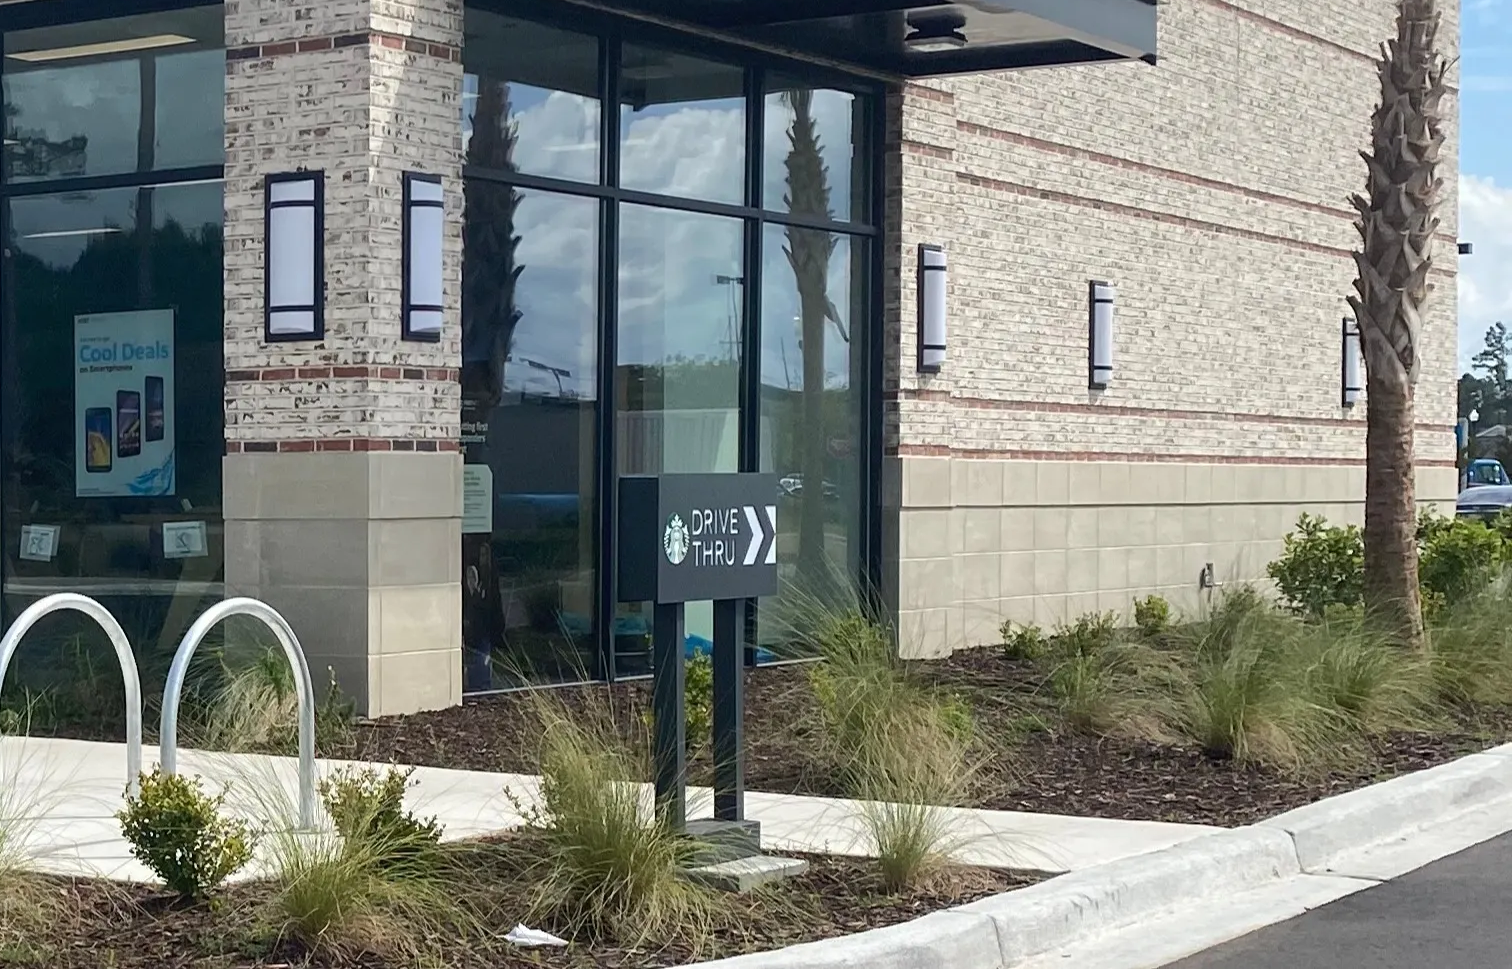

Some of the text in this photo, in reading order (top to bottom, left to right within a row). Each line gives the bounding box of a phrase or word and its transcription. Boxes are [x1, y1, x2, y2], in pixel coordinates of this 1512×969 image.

[80, 340, 169, 362] Cool Deals
[692, 508, 738, 535] DRIVE
[692, 540, 735, 566] THRU
